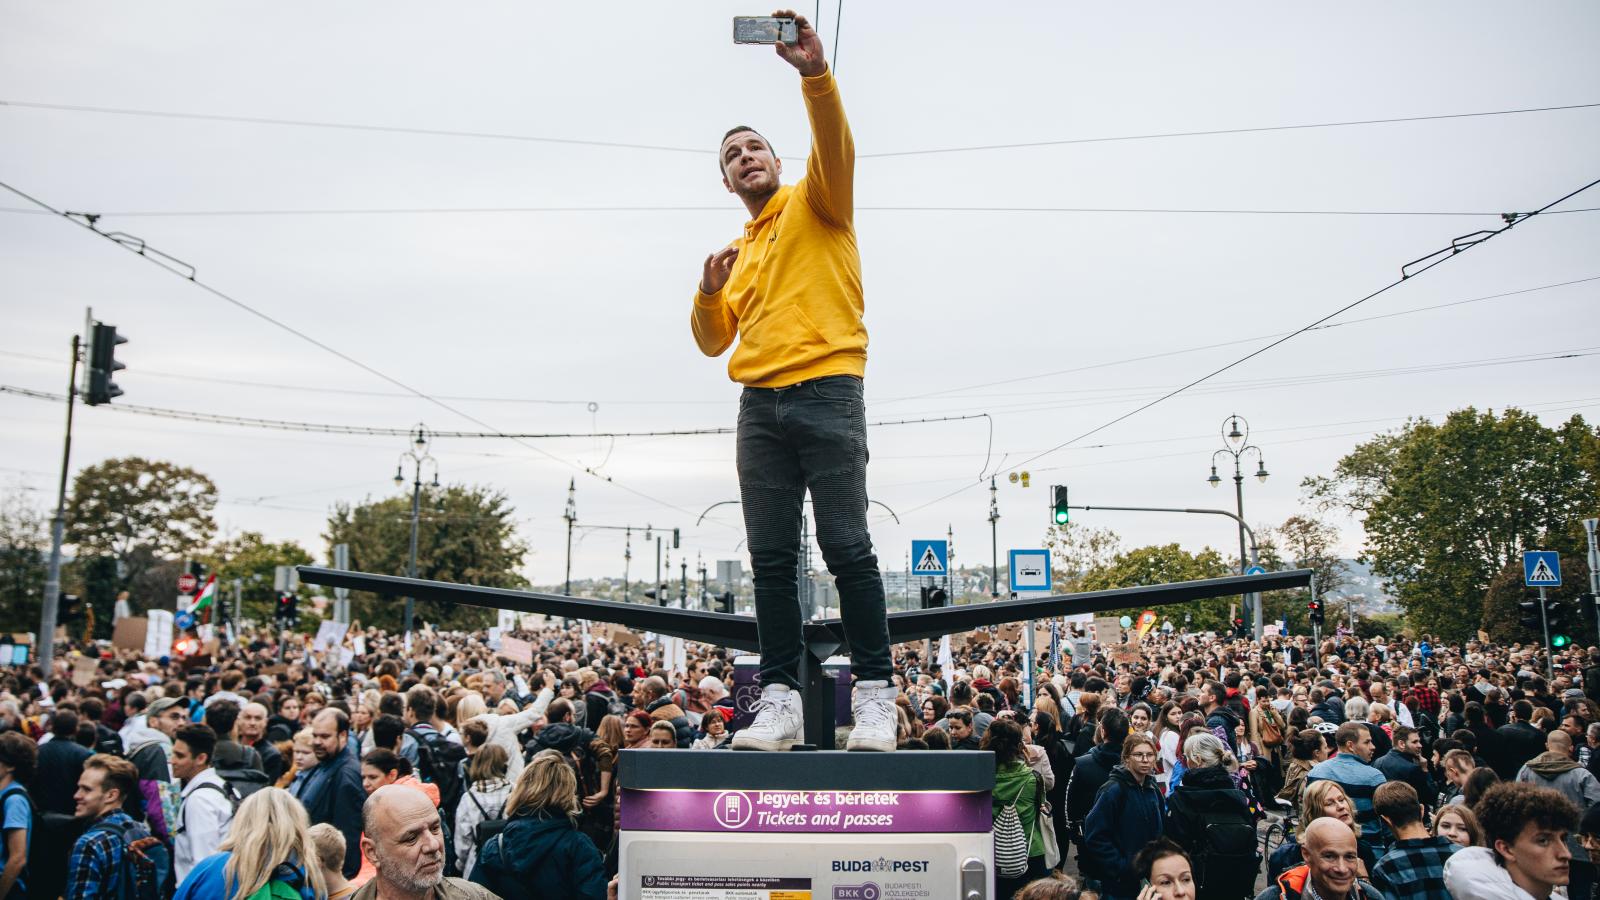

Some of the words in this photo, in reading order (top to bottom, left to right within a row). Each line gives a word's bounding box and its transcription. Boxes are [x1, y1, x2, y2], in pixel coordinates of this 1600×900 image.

[757, 792, 810, 808] Jegyek
[814, 793, 832, 805] és
[836, 792, 899, 805] bérletek
[758, 812, 807, 826] Tickets
[811, 811, 841, 826] and
[844, 814, 893, 828] passes
